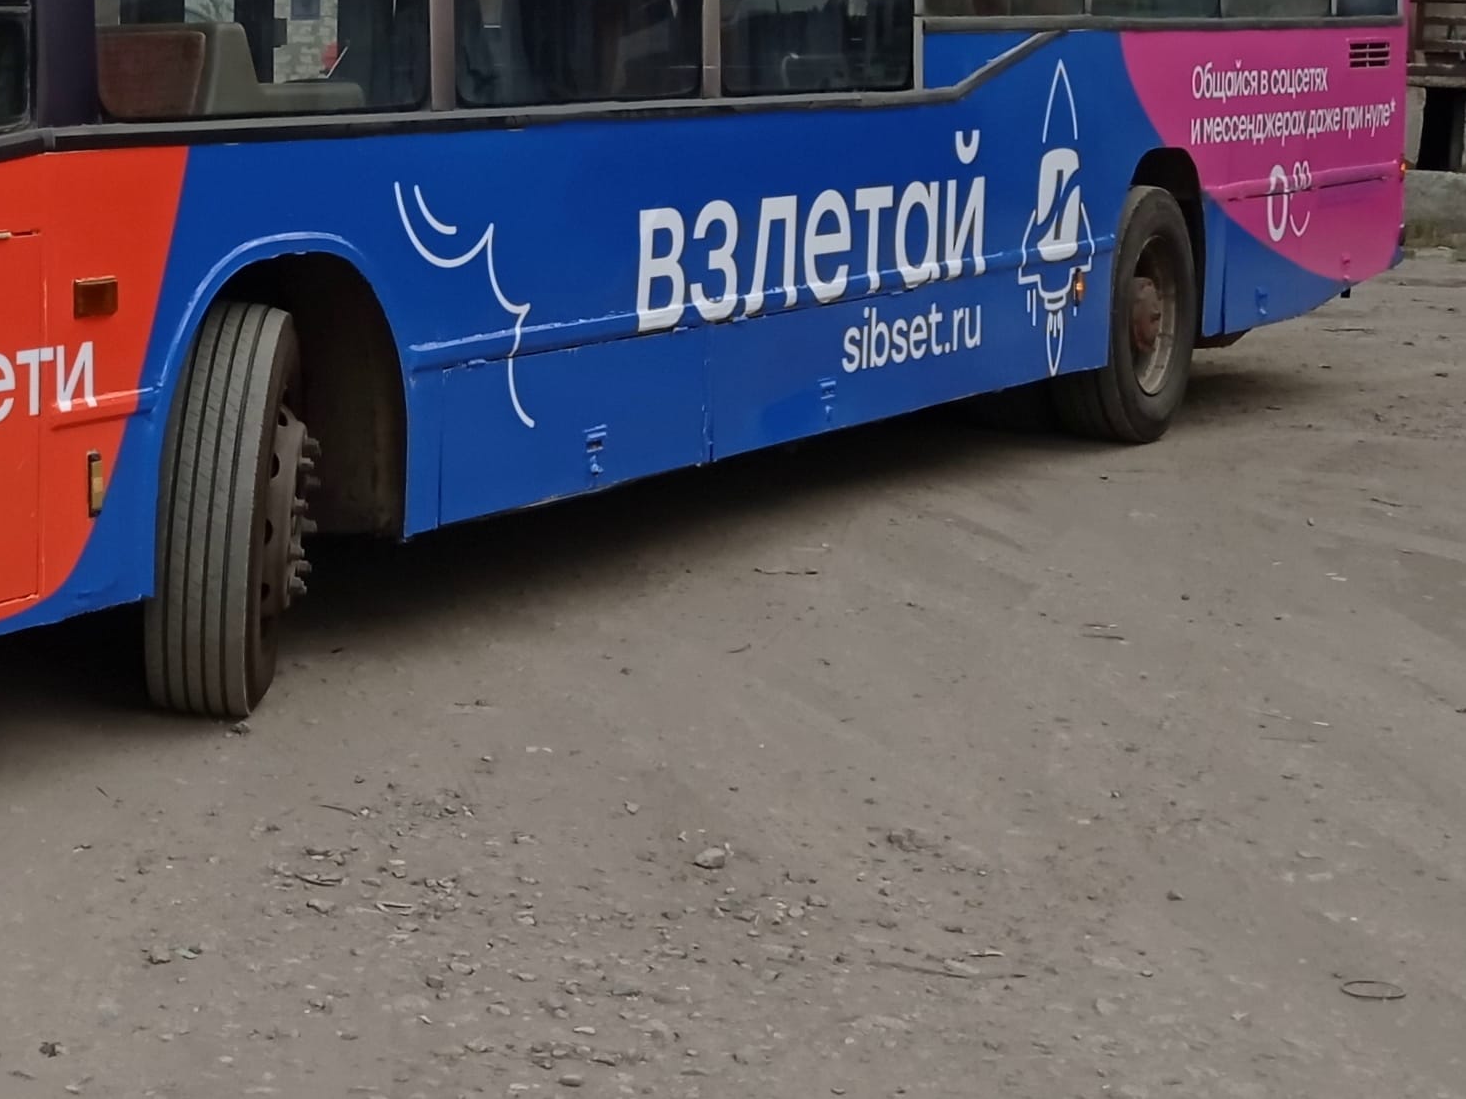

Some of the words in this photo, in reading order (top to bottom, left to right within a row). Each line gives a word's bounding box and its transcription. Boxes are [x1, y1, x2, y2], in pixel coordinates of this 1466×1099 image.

[1191, 59, 1259, 104] Общайся
[1260, 71, 1269, 96] в
[1271, 66, 1329, 99] соцсетях
[1190, 117, 1202, 146] и
[1203, 110, 1307, 147] мессенджерах
[1307, 105, 1341, 140] даже
[1342, 104, 1364, 139] при
[842, 304, 982, 374] sibset.ru
